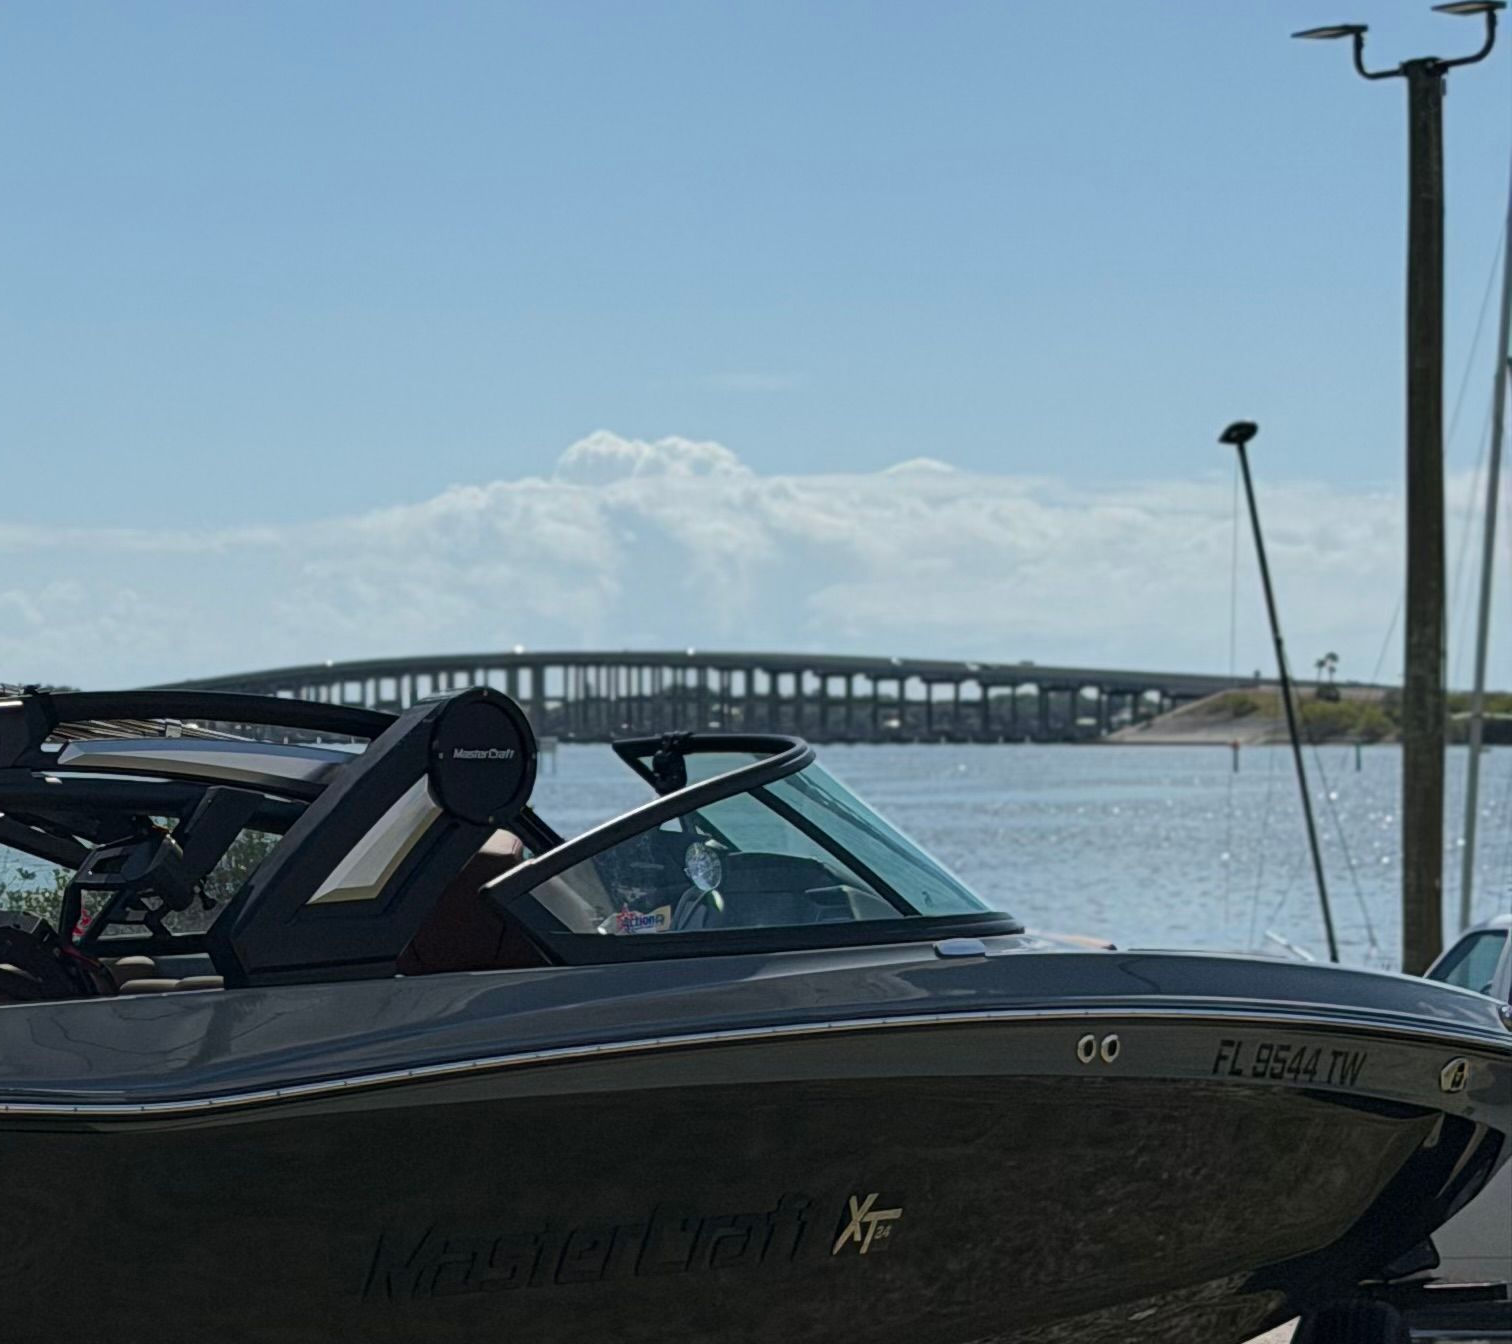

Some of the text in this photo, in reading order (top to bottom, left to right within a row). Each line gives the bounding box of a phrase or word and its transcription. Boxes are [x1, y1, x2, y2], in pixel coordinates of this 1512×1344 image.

[453, 748, 515, 759] MasterCraft
[1213, 1039, 1367, 1086] FL 9544 TW
[362, 1194, 813, 1301] MasterCraft
[832, 1192, 903, 1256] XT
